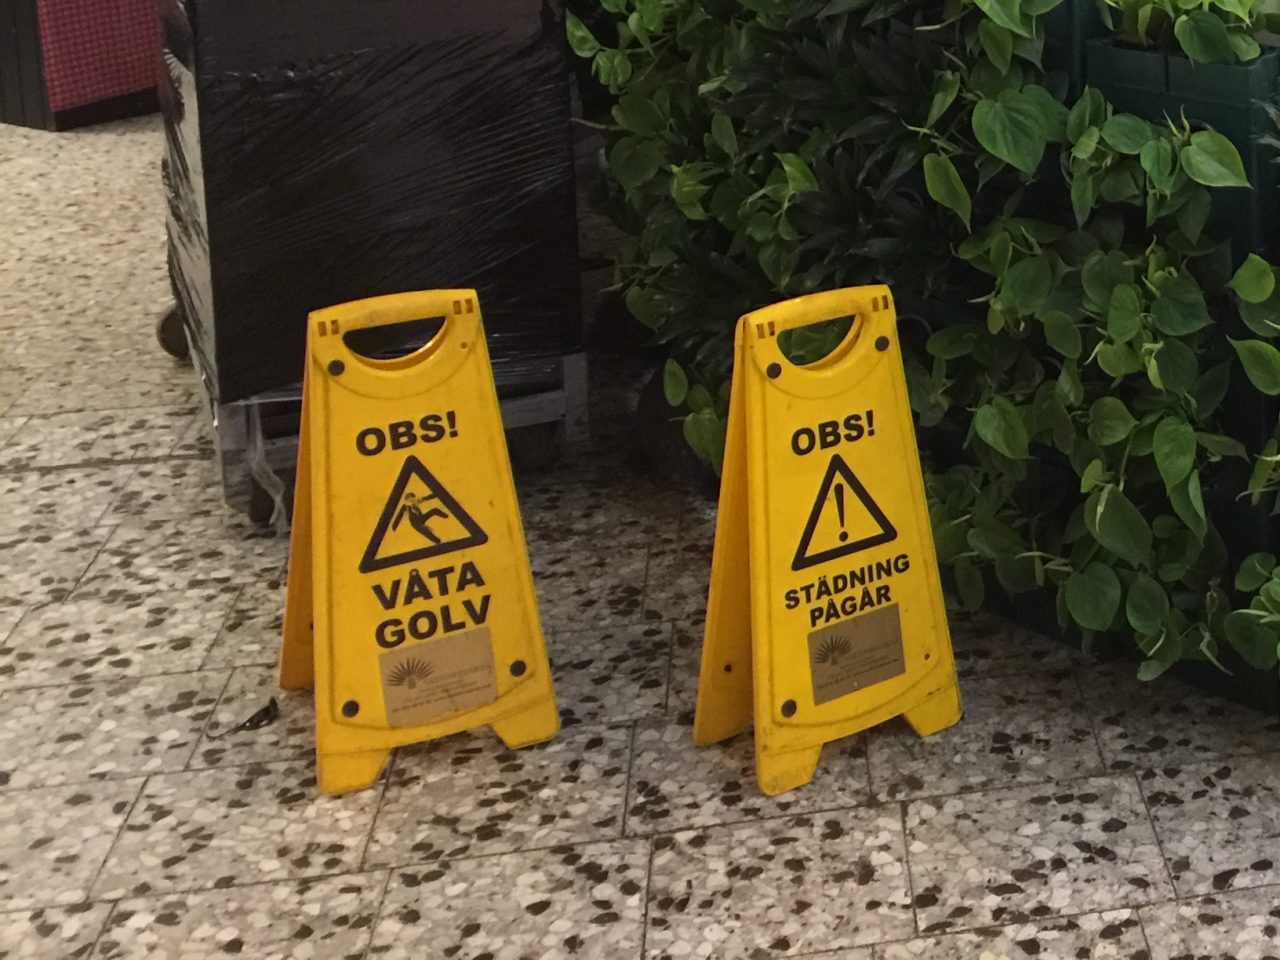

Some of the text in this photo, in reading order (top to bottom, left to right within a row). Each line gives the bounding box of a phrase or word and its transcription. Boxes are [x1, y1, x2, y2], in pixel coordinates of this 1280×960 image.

[356, 410, 458, 456] OBS!
[791, 409, 876, 456] OBS!
[371, 561, 486, 611] VÅTA
[784, 553, 910, 610] STÄDNING
[375, 594, 491, 649] GOLV
[809, 584, 892, 628] PÅGÅR
